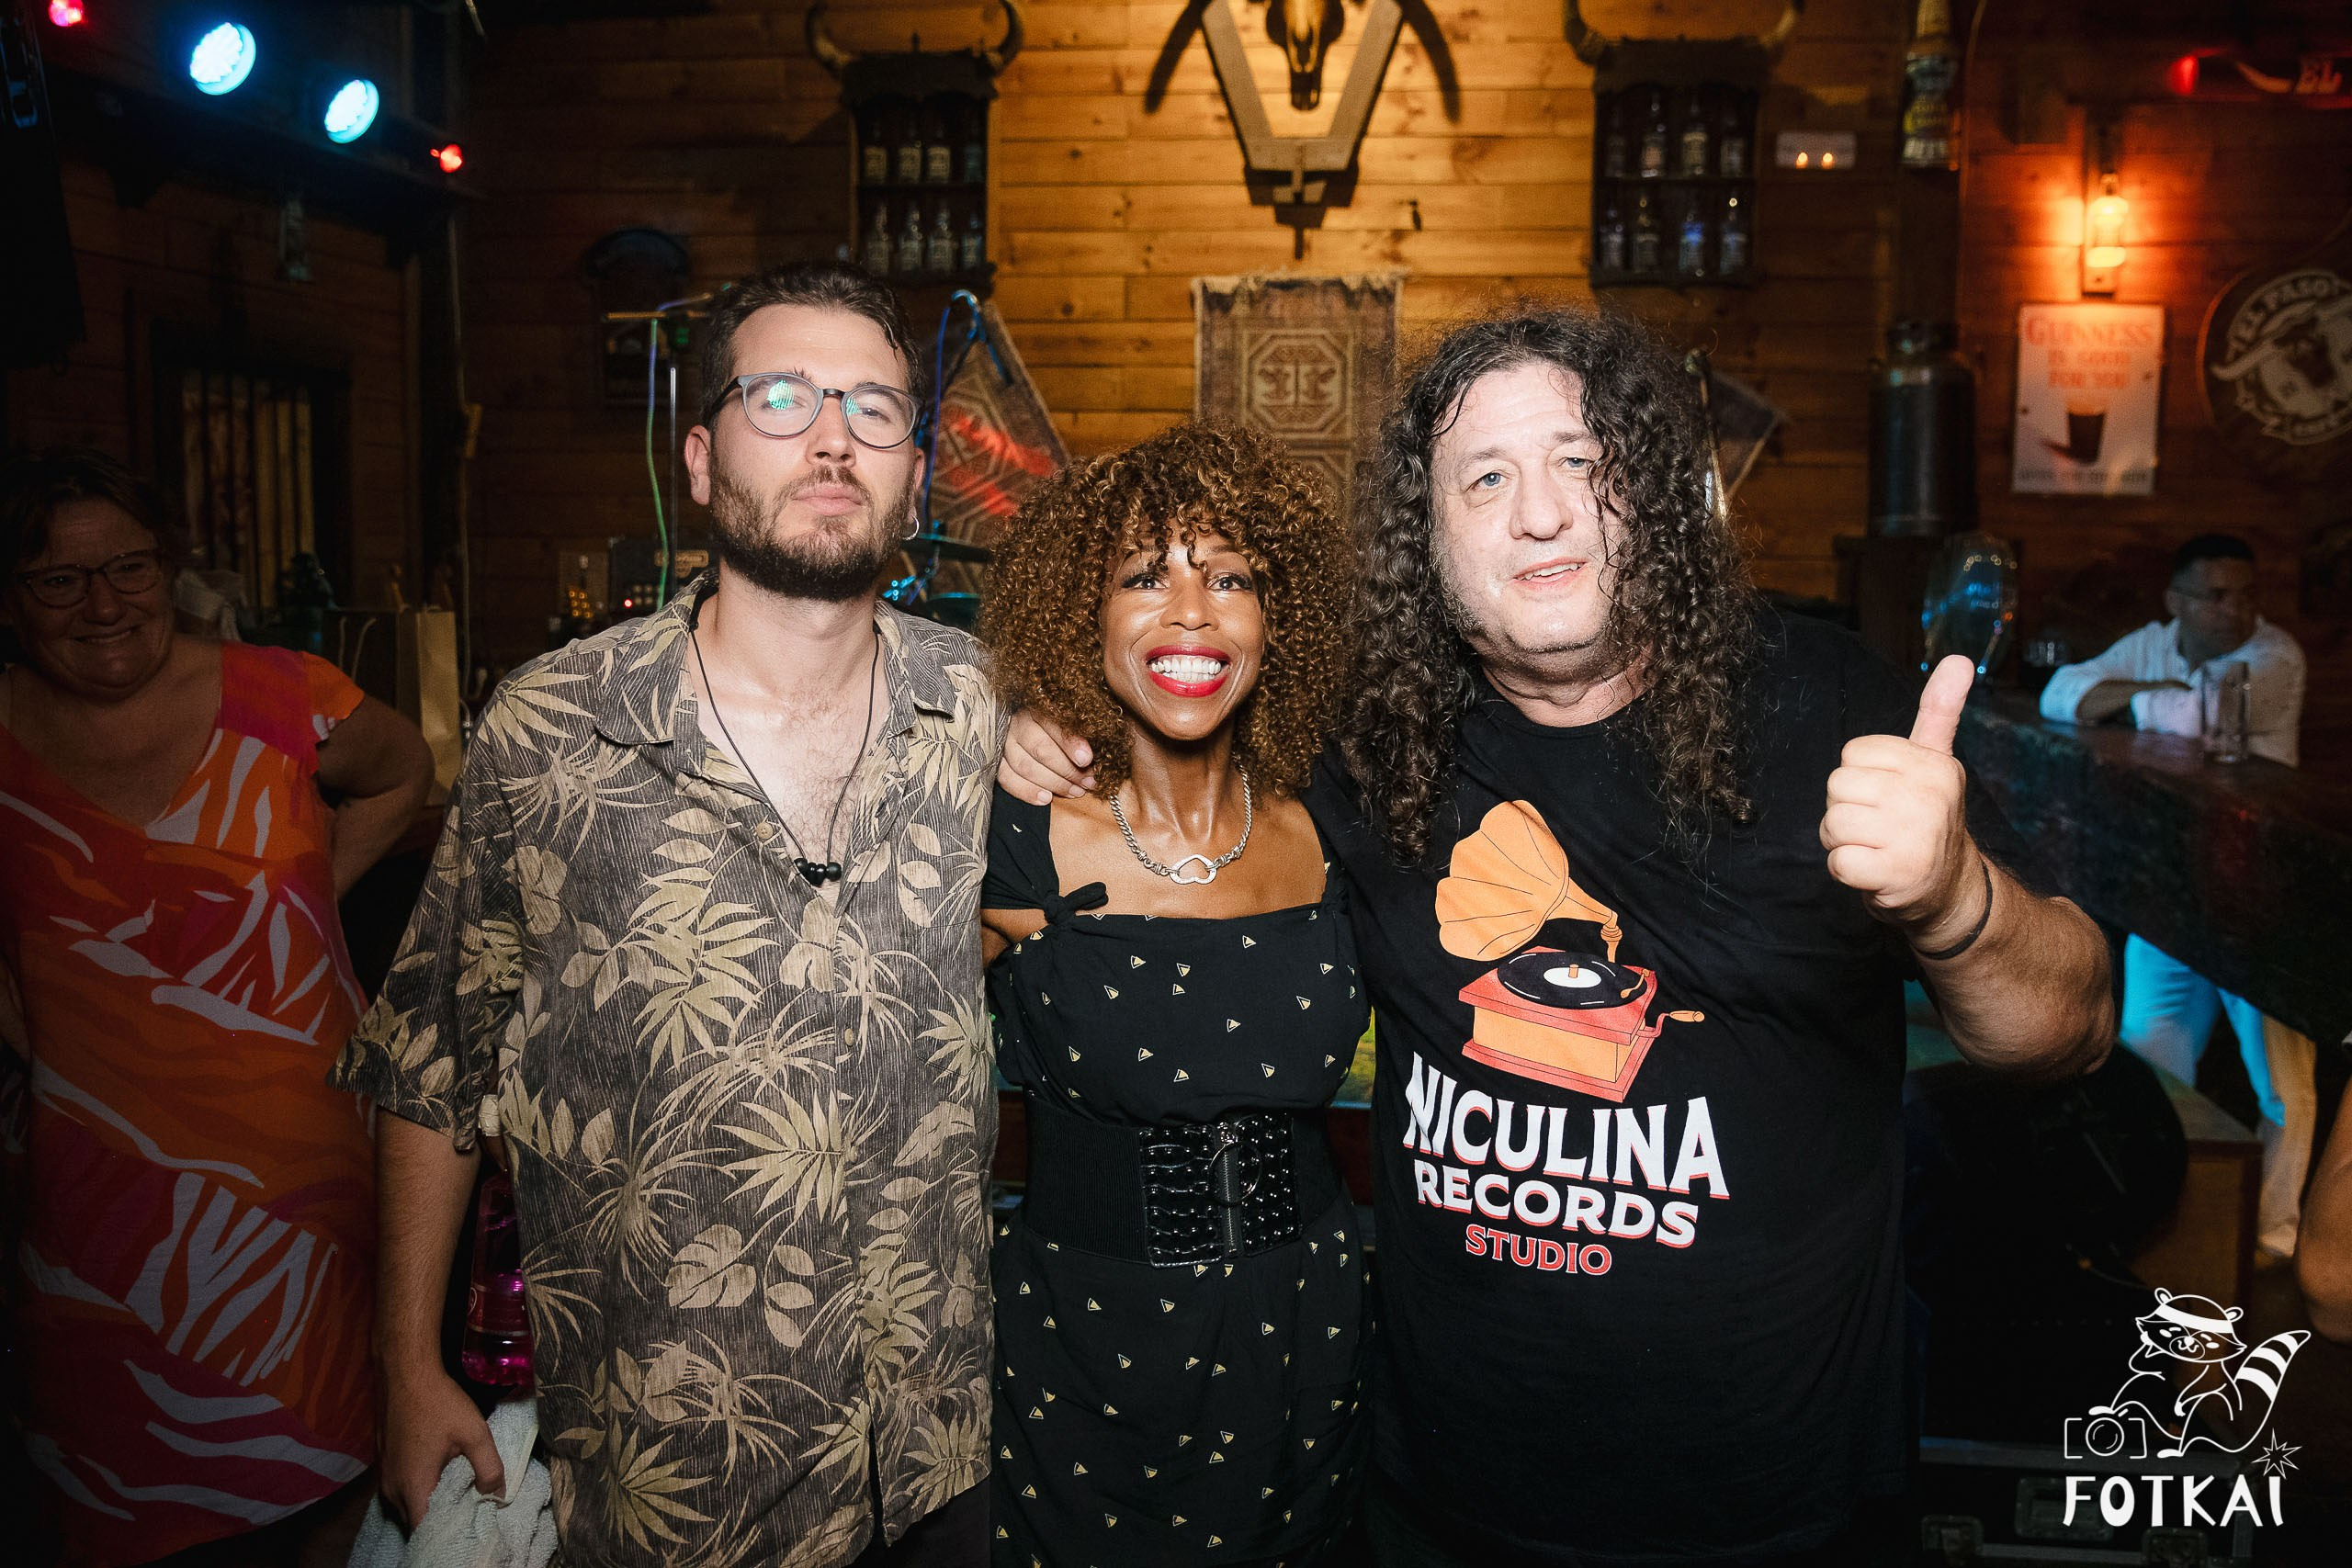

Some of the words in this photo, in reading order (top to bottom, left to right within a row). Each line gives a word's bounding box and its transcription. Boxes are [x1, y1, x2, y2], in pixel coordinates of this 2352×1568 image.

[2026, 316, 2154, 346] GUINNESS
[1403, 1051, 1730, 1200] NICULINA
[1414, 1158, 1699, 1248] RECORDS
[1465, 1224, 1611, 1276] STUDIO
